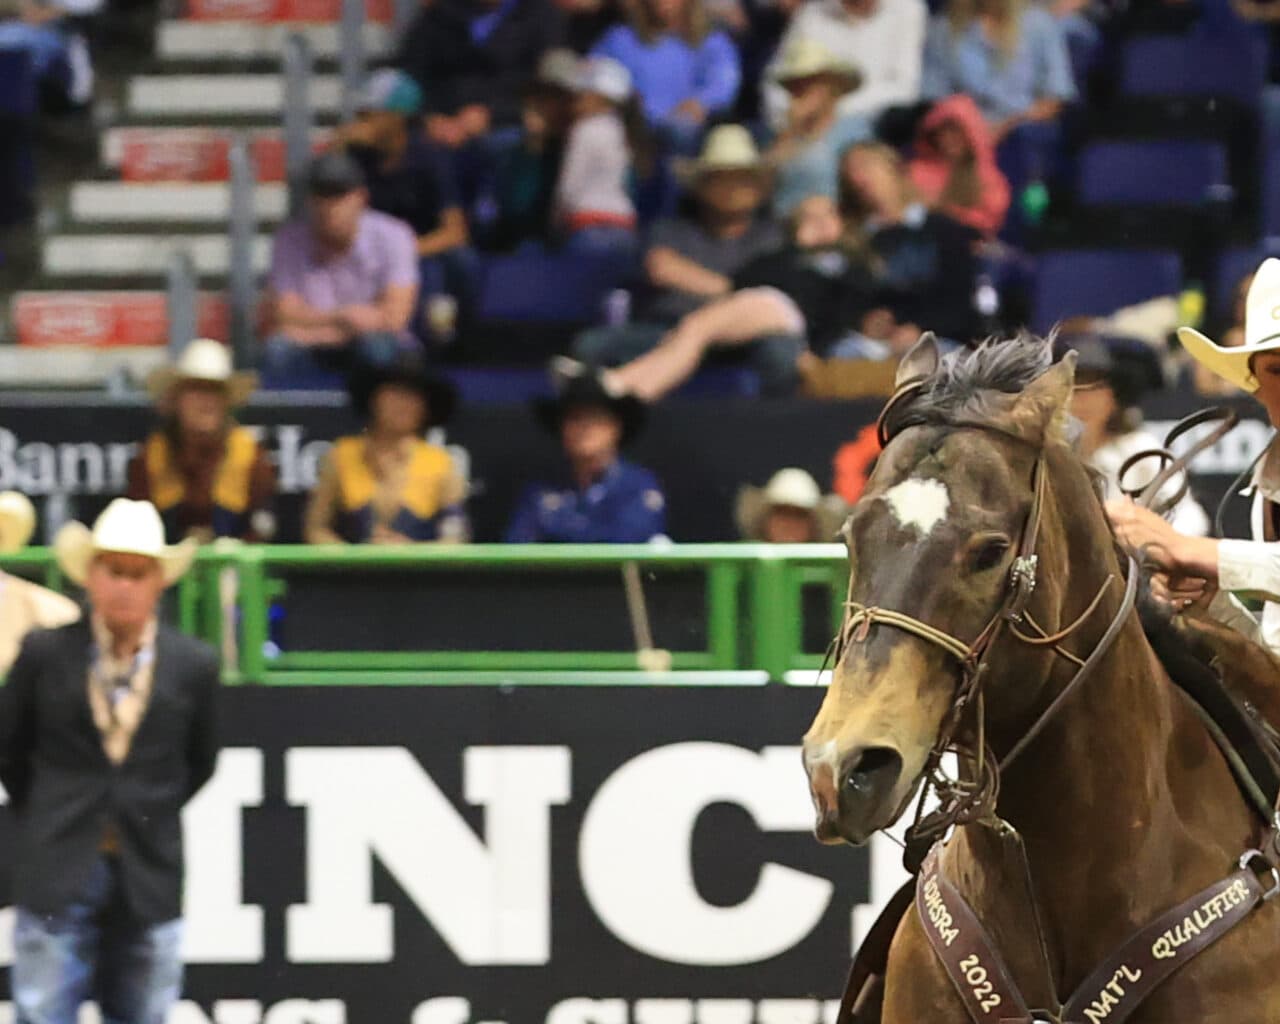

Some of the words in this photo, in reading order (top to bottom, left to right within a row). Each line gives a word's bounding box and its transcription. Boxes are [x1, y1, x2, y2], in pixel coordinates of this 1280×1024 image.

[181, 741, 915, 966] INC
[1151, 878, 1250, 960] QUALIFIER
[959, 953, 1001, 1014] 2022
